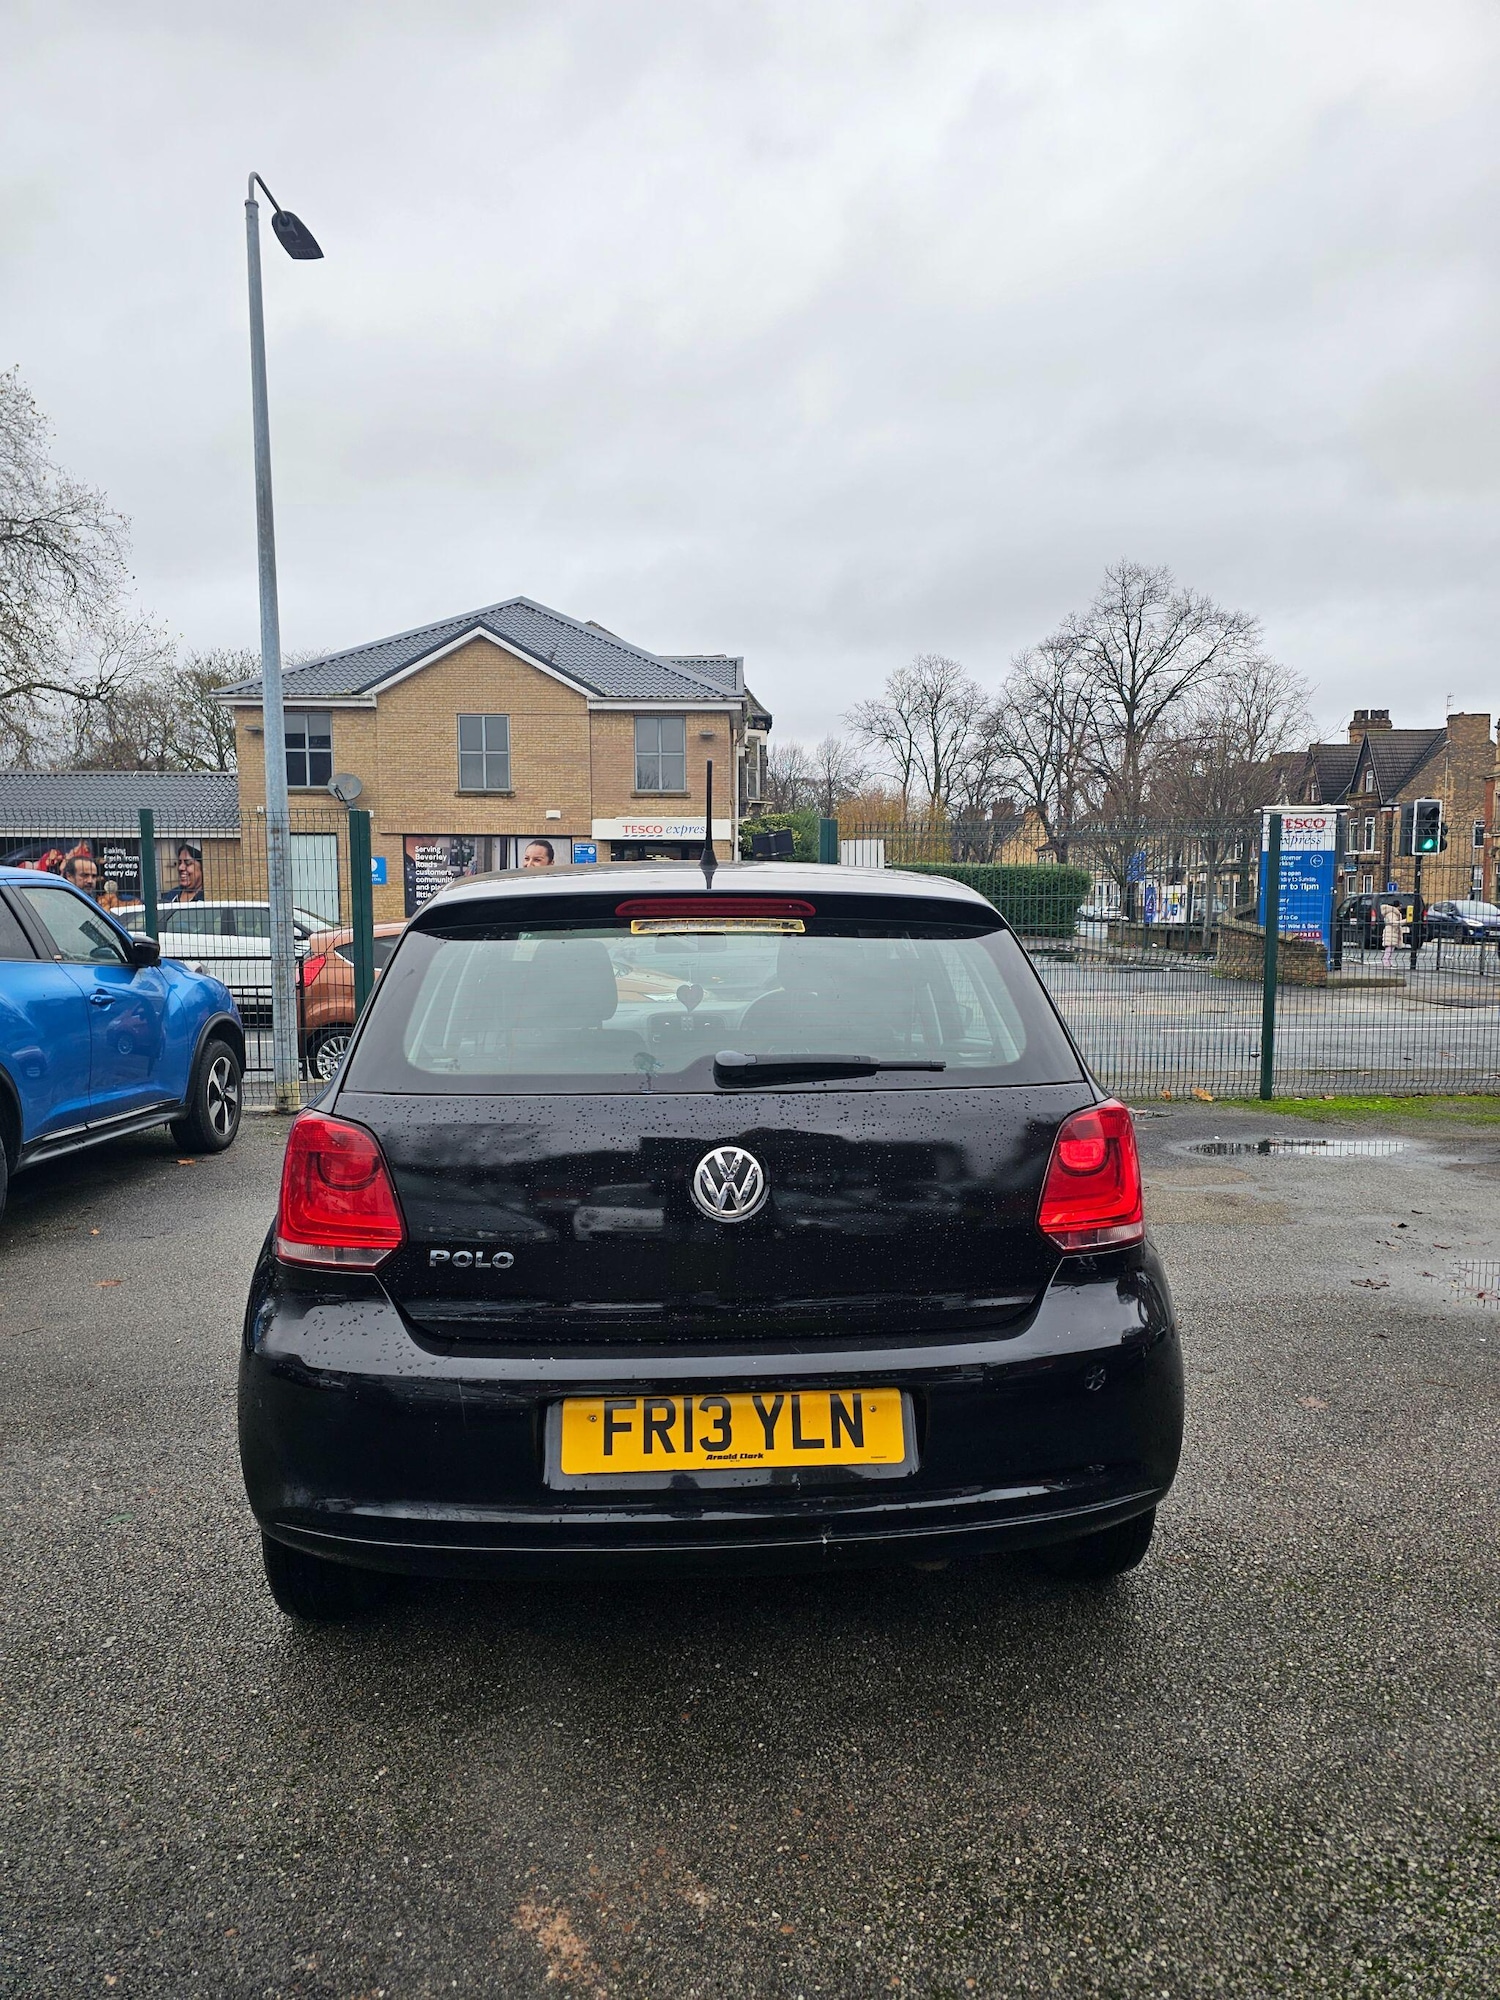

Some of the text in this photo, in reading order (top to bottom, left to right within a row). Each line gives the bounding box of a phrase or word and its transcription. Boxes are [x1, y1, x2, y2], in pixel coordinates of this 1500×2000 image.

[622, 825, 707, 837] TESCO expres
[1280, 836, 1322, 847] xpress
[415, 846, 441, 854] Serving
[415, 853, 447, 861] Beverley
[429, 1250, 515, 1269] POLO
[603, 1393, 864, 1456] FR13 YLN
[706, 1452, 764, 1461] Arnold Clark
